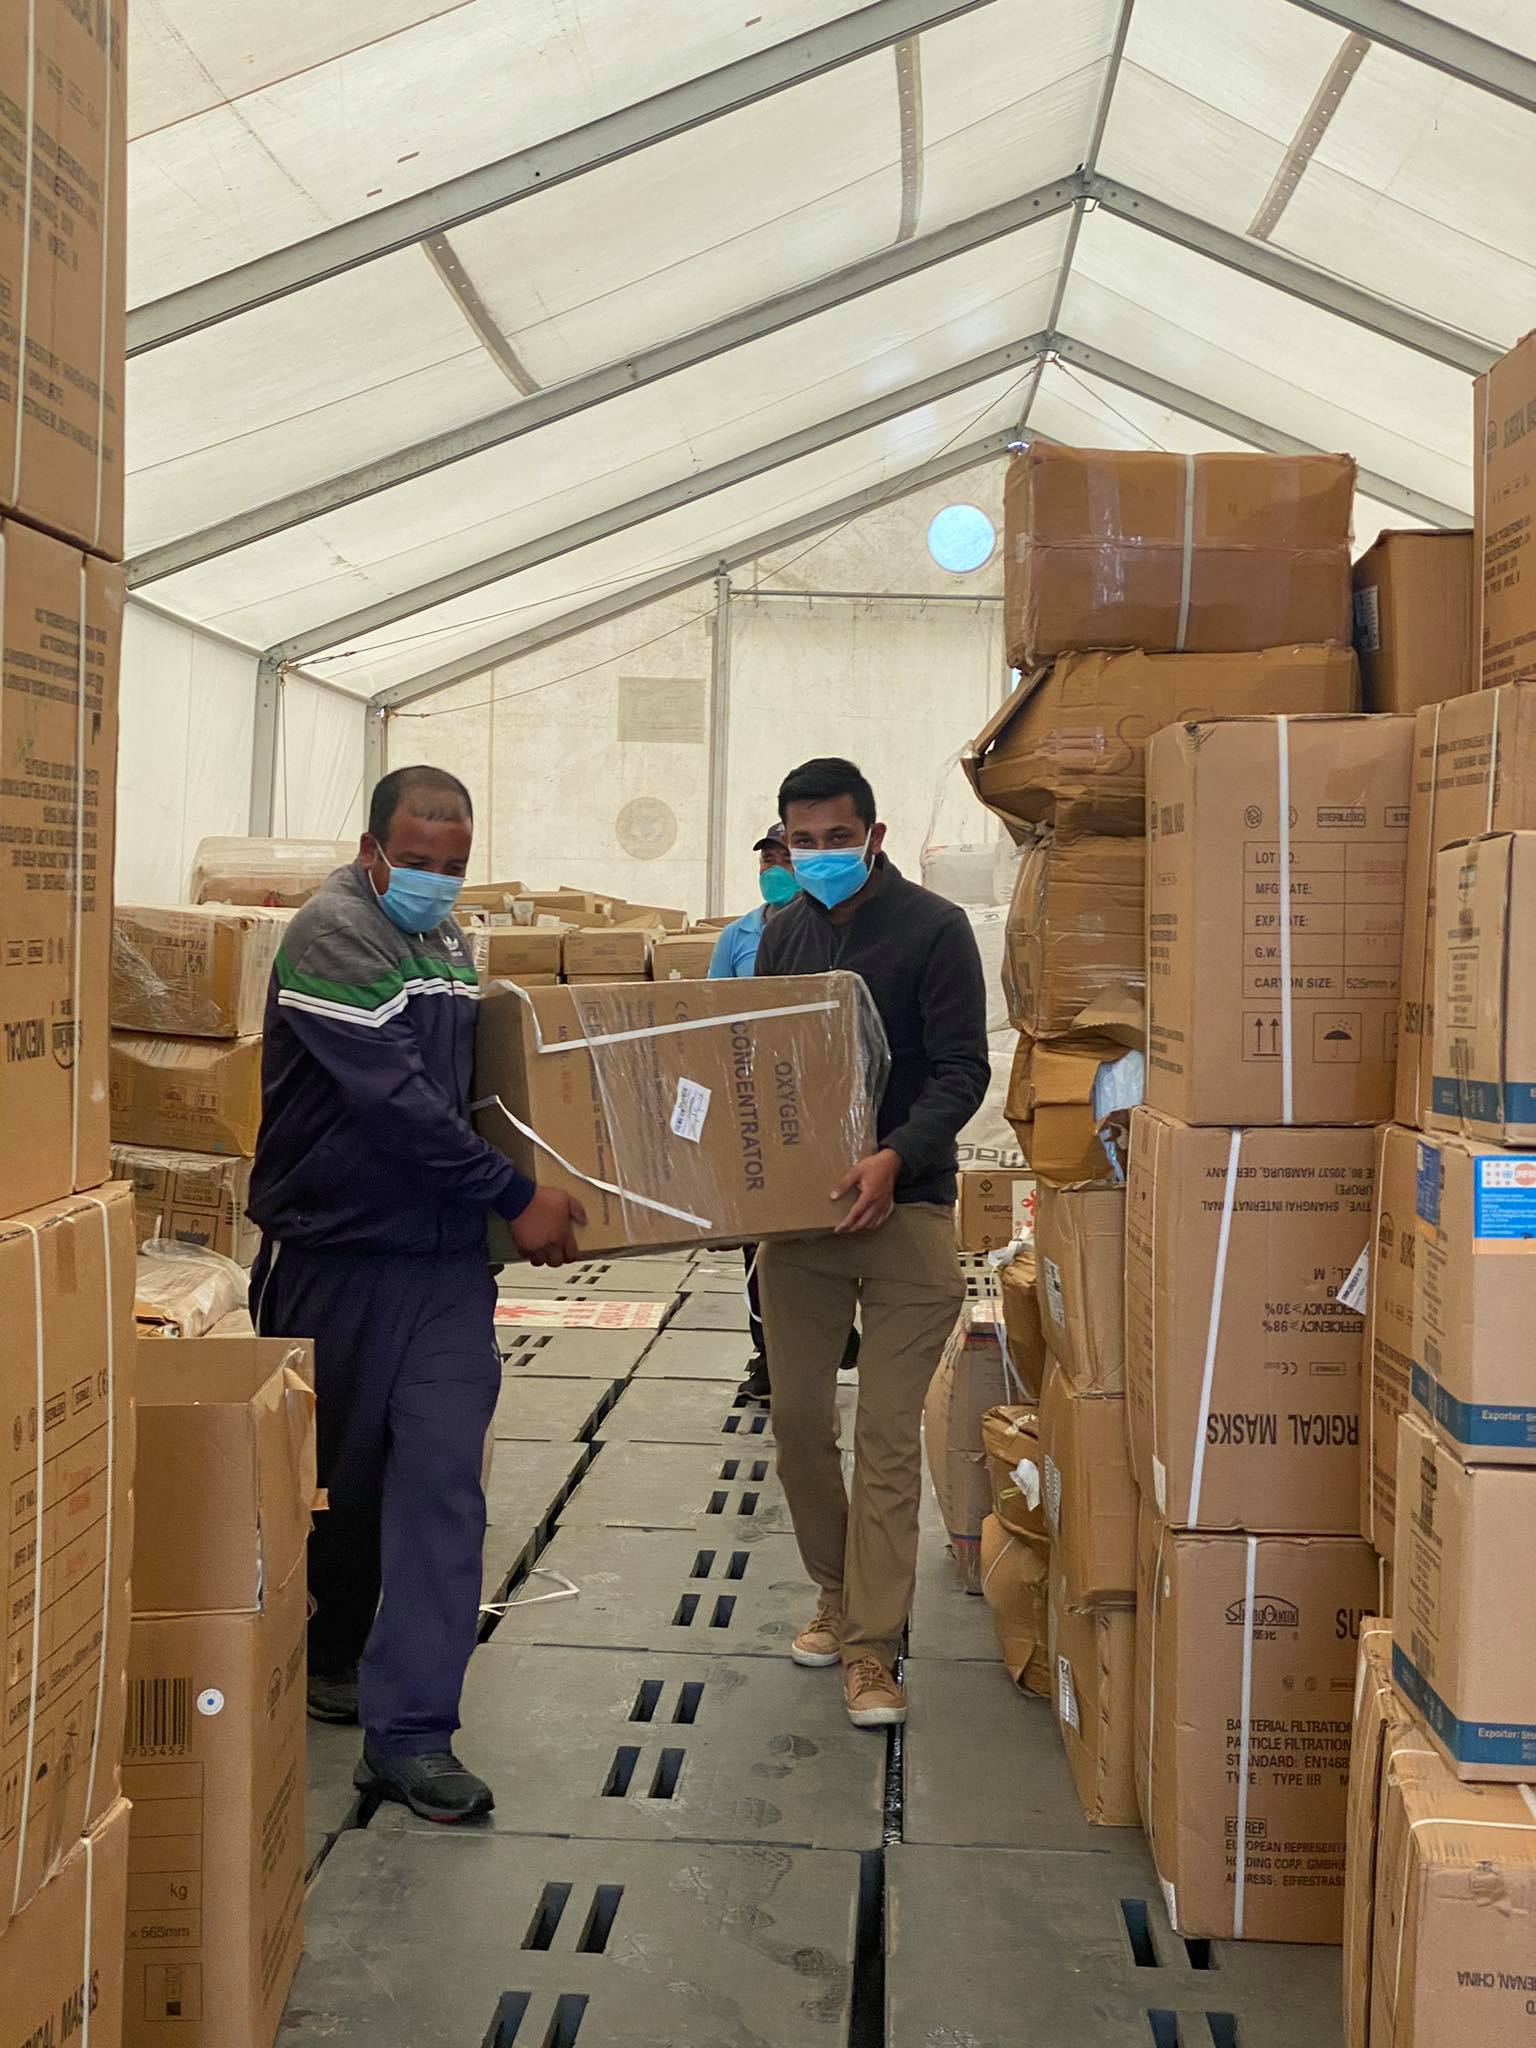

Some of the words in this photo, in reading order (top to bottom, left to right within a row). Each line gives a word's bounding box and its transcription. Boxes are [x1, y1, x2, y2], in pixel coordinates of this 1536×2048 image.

[1255, 852, 1275, 864] LOT
[1255, 883, 1279, 894] MFG
[1280, 883, 1312, 894] ATE:
[1255, 915, 1275, 927] EXP
[730, 1021, 765, 1192] CONCENTRATOR
[775, 1061, 799, 1147] OXYGEN
[1202, 1167, 1257, 1179] GERANY.
[1285, 1200, 1339, 1212] SHANGHAI
[1206, 1412, 1278, 1446] MASKS
[1288, 1412, 1359, 1446] RGICAL
[1226, 1718, 1288, 1733] BATERIAL
[1226, 1735, 1282, 1750] PATICLE
[1272, 1773, 1304, 1786] TYPE
[170, 1883, 188, 1901] kg
[140, 1926, 190, 1939] 565mm
[1456, 1971, 1495, 1987] CHINA
